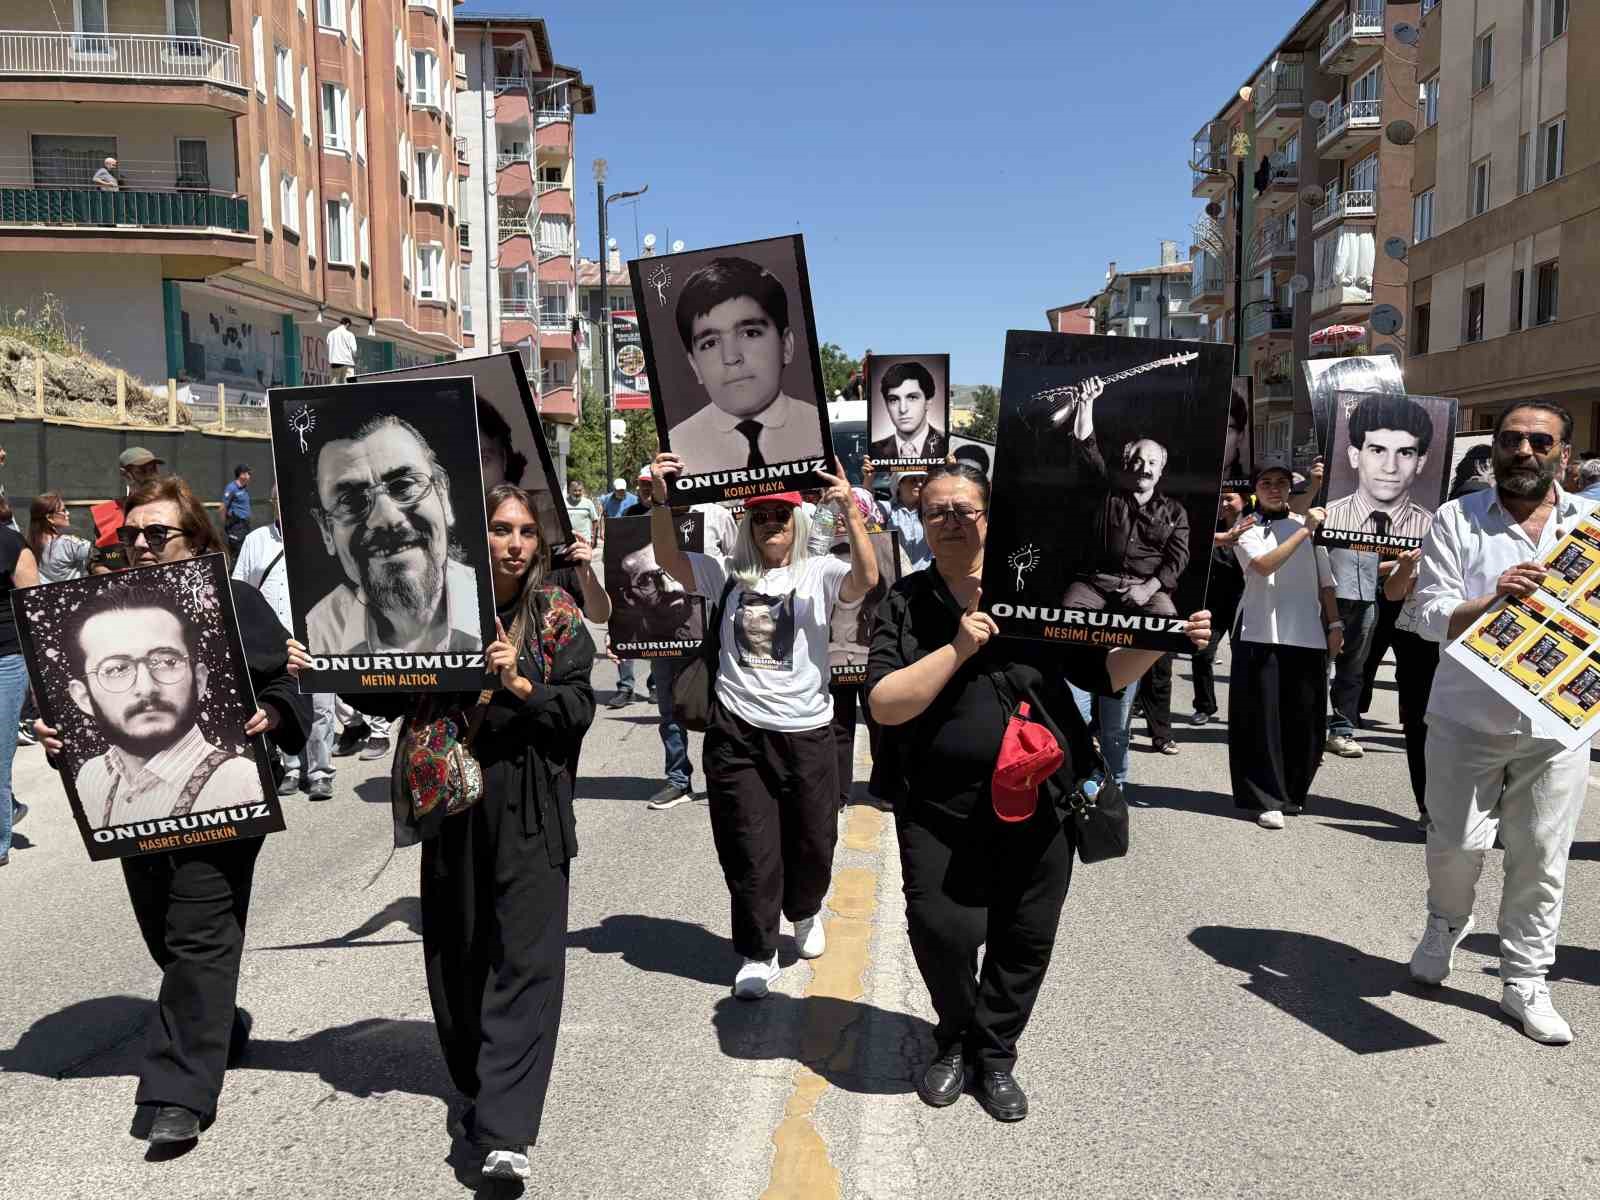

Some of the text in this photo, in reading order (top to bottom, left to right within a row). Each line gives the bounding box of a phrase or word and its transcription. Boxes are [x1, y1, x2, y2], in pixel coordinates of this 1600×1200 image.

[871, 458, 945, 466] ONURUMUZ
[675, 459, 828, 491] ONURUMUZ
[723, 480, 785, 498] KORAY KAYA
[1321, 530, 1420, 548] ONURUMU
[1349, 543, 1375, 552] AHMET
[991, 603, 1187, 634] ONURUMUZ
[1043, 625, 1134, 647] NESİMİ ÇİMEN
[616, 640, 703, 651] ONURUMUZ
[312, 654, 486, 671] ONURUMUZ
[832, 665, 866, 675] URU
[361, 671, 438, 687] METİN ALTIOK
[93, 803, 271, 843] ONURUMUZ
[138, 825, 238, 852] HASRET GÜLTEKİN
